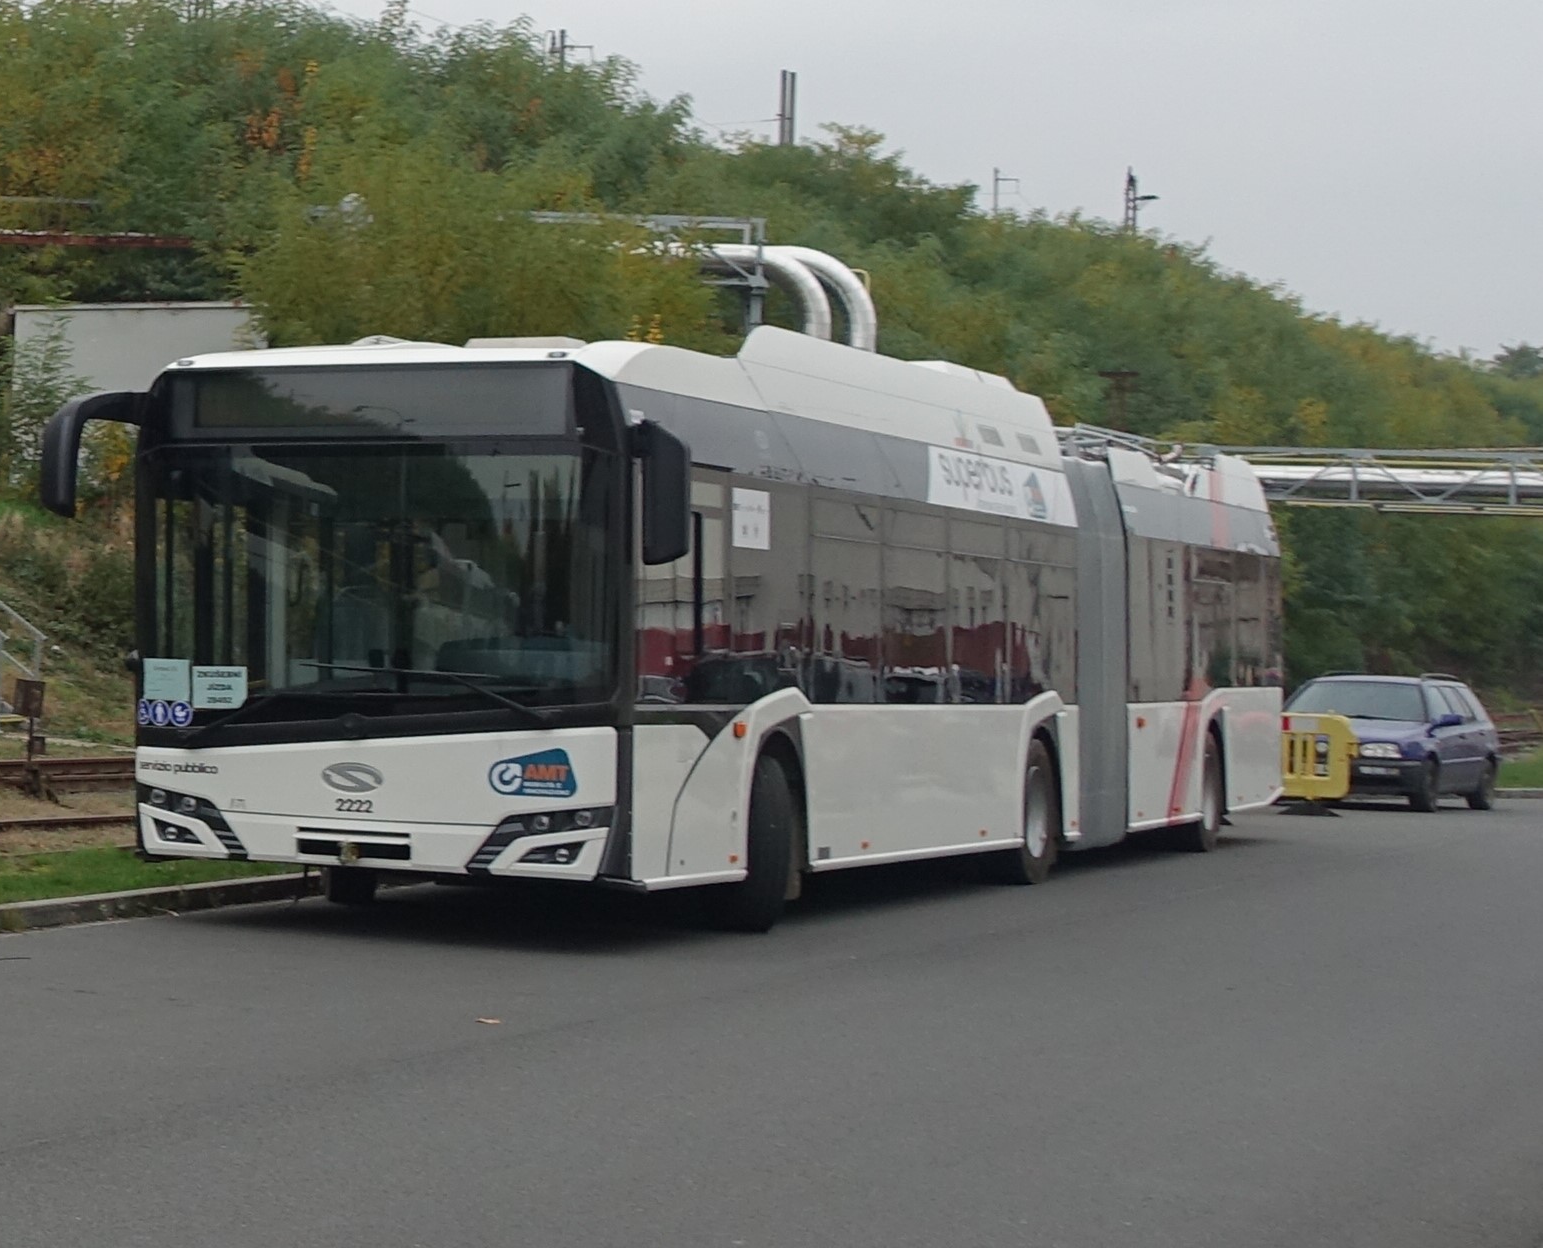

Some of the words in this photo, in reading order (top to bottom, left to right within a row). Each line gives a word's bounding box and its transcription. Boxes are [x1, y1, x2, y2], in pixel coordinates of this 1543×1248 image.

[174, 760, 219, 775] pubblico
[524, 763, 570, 782] AMT
[335, 798, 374, 813] 2222
